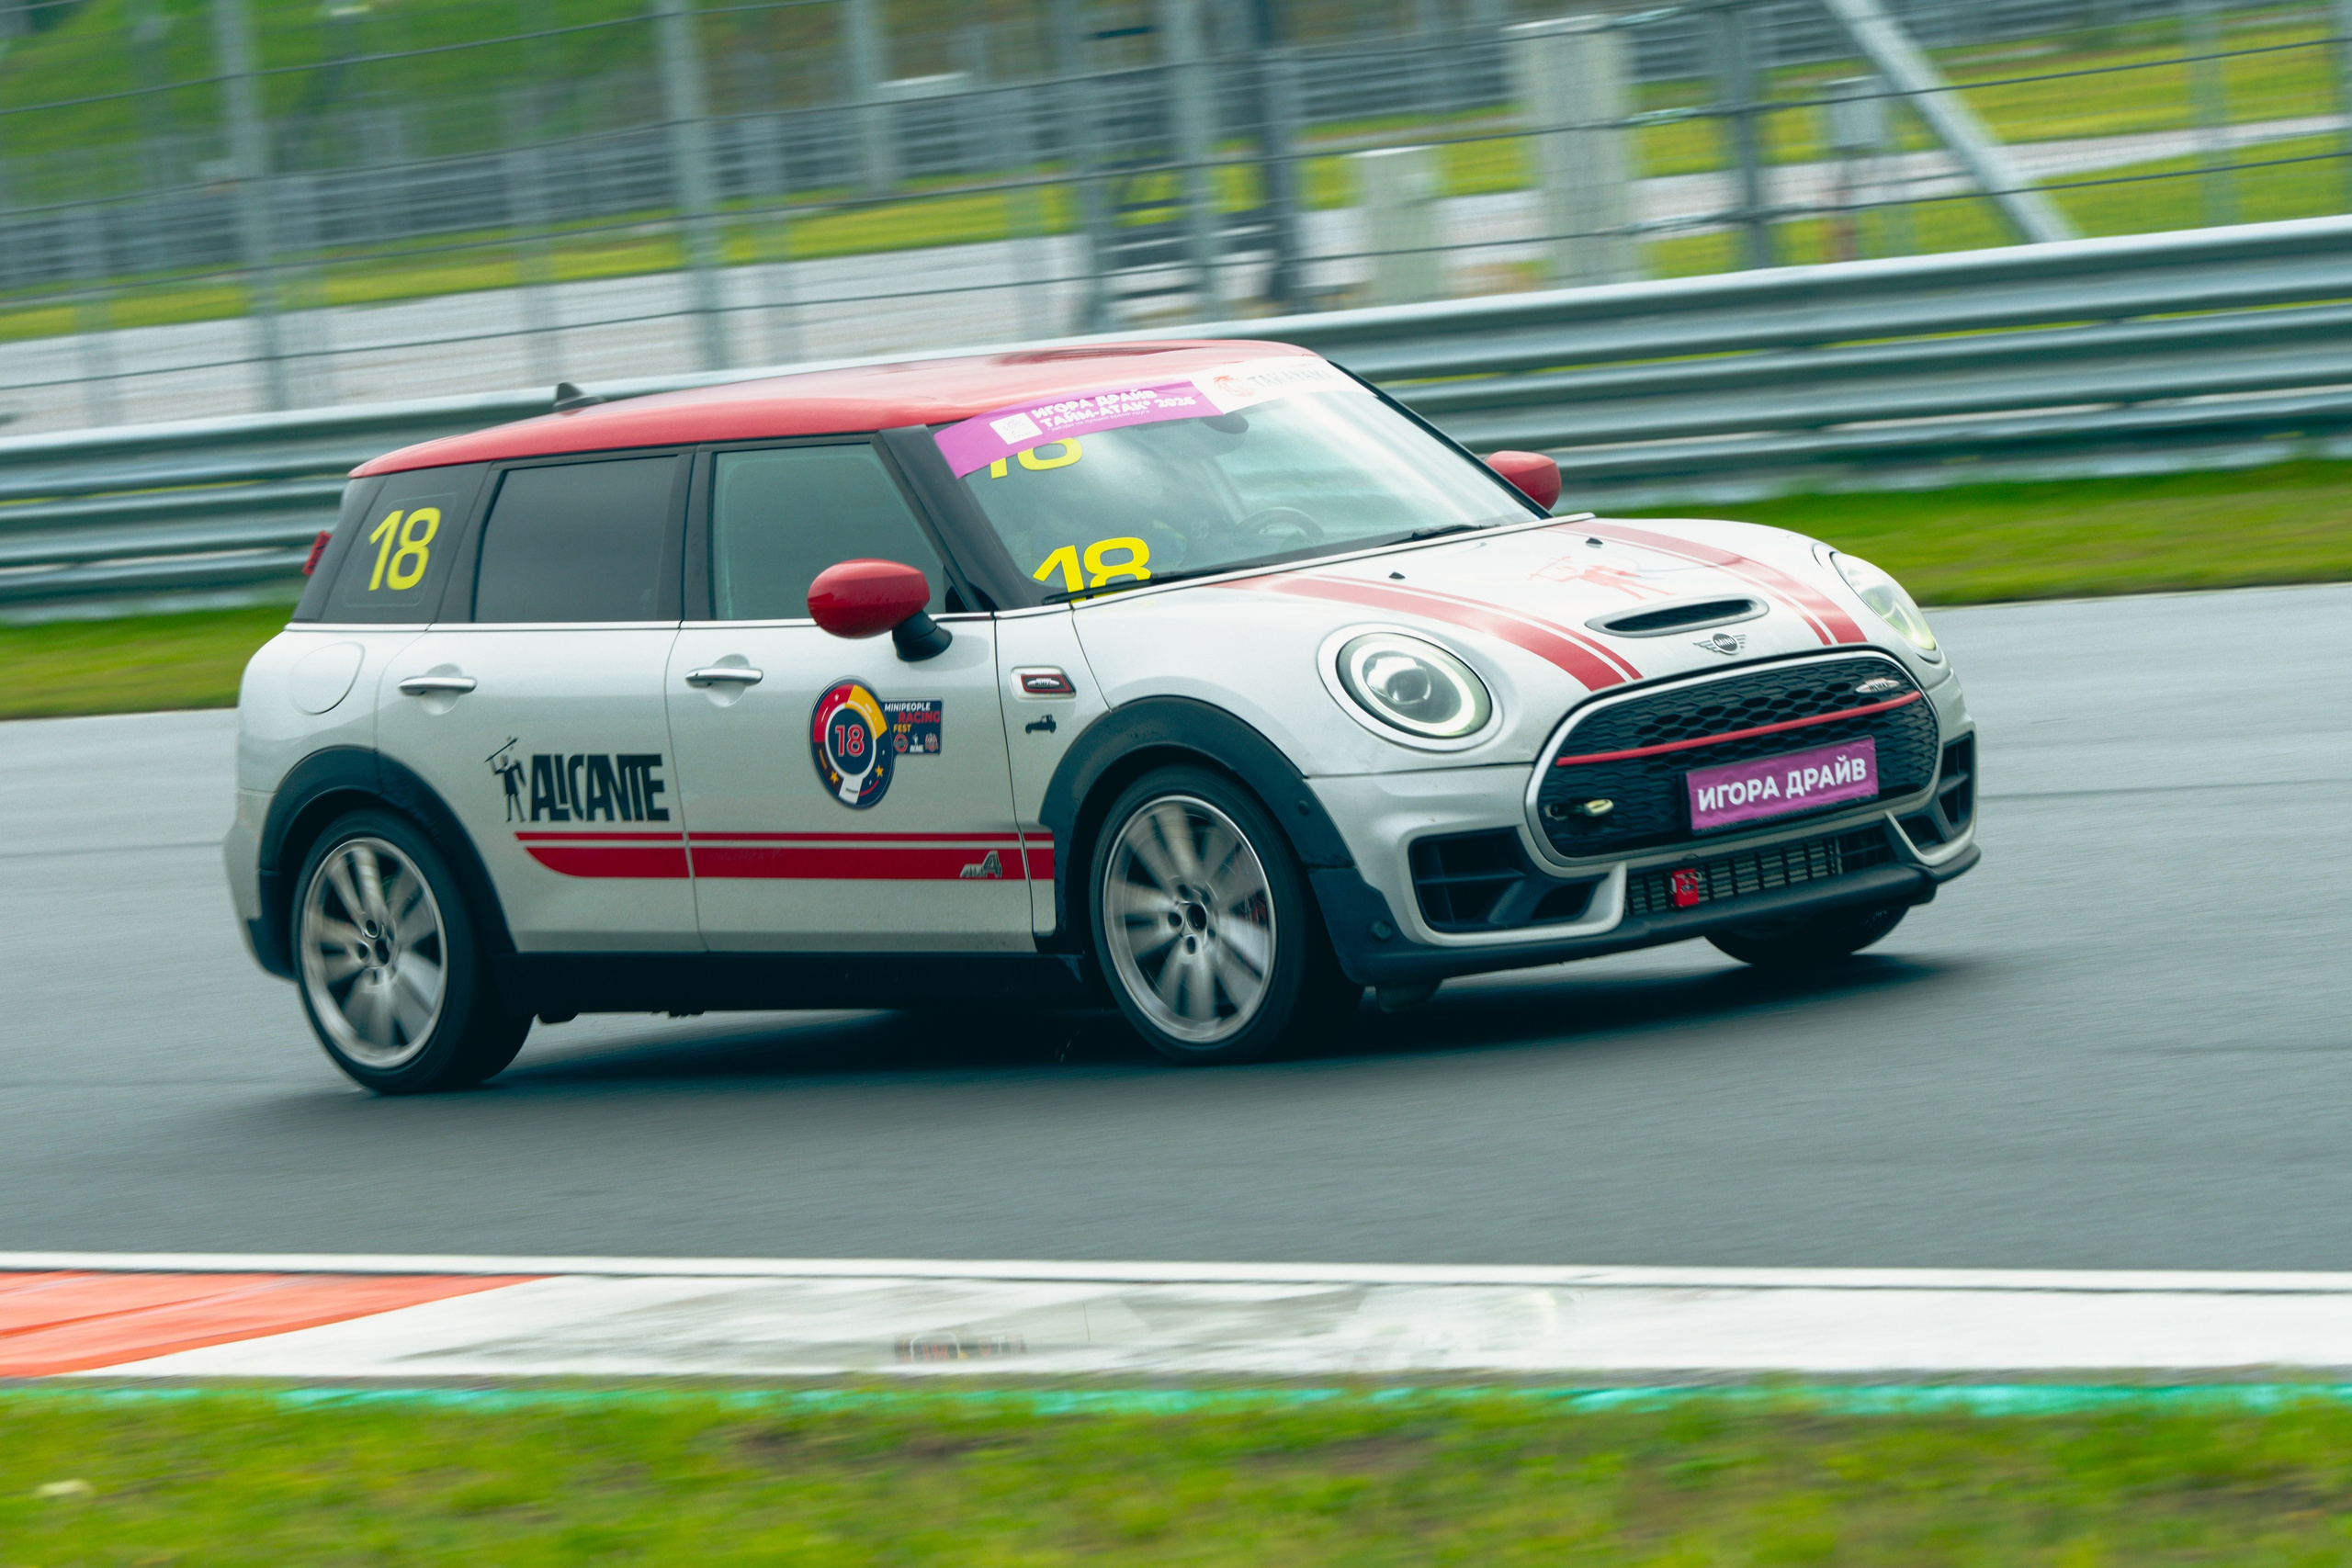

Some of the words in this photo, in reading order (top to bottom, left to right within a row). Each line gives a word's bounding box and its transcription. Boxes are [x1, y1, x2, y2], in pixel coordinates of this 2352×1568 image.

[1031, 399, 1093, 419] ИГОРА
[1095, 389, 1158, 407] ДРАЙВ
[368, 507, 441, 592] 18
[1033, 537, 1151, 604] 18
[1713, 637, 1736, 647] MINI
[885, 702, 931, 712] MINIPEOPLE
[898, 710, 941, 724] RACING
[835, 724, 865, 757] 18
[893, 723, 912, 733] FEST
[530, 753, 670, 822] ALICANTE
[1698, 776, 1781, 812] ИГОРА
[1785, 755, 1866, 799] ДРАЙВ
